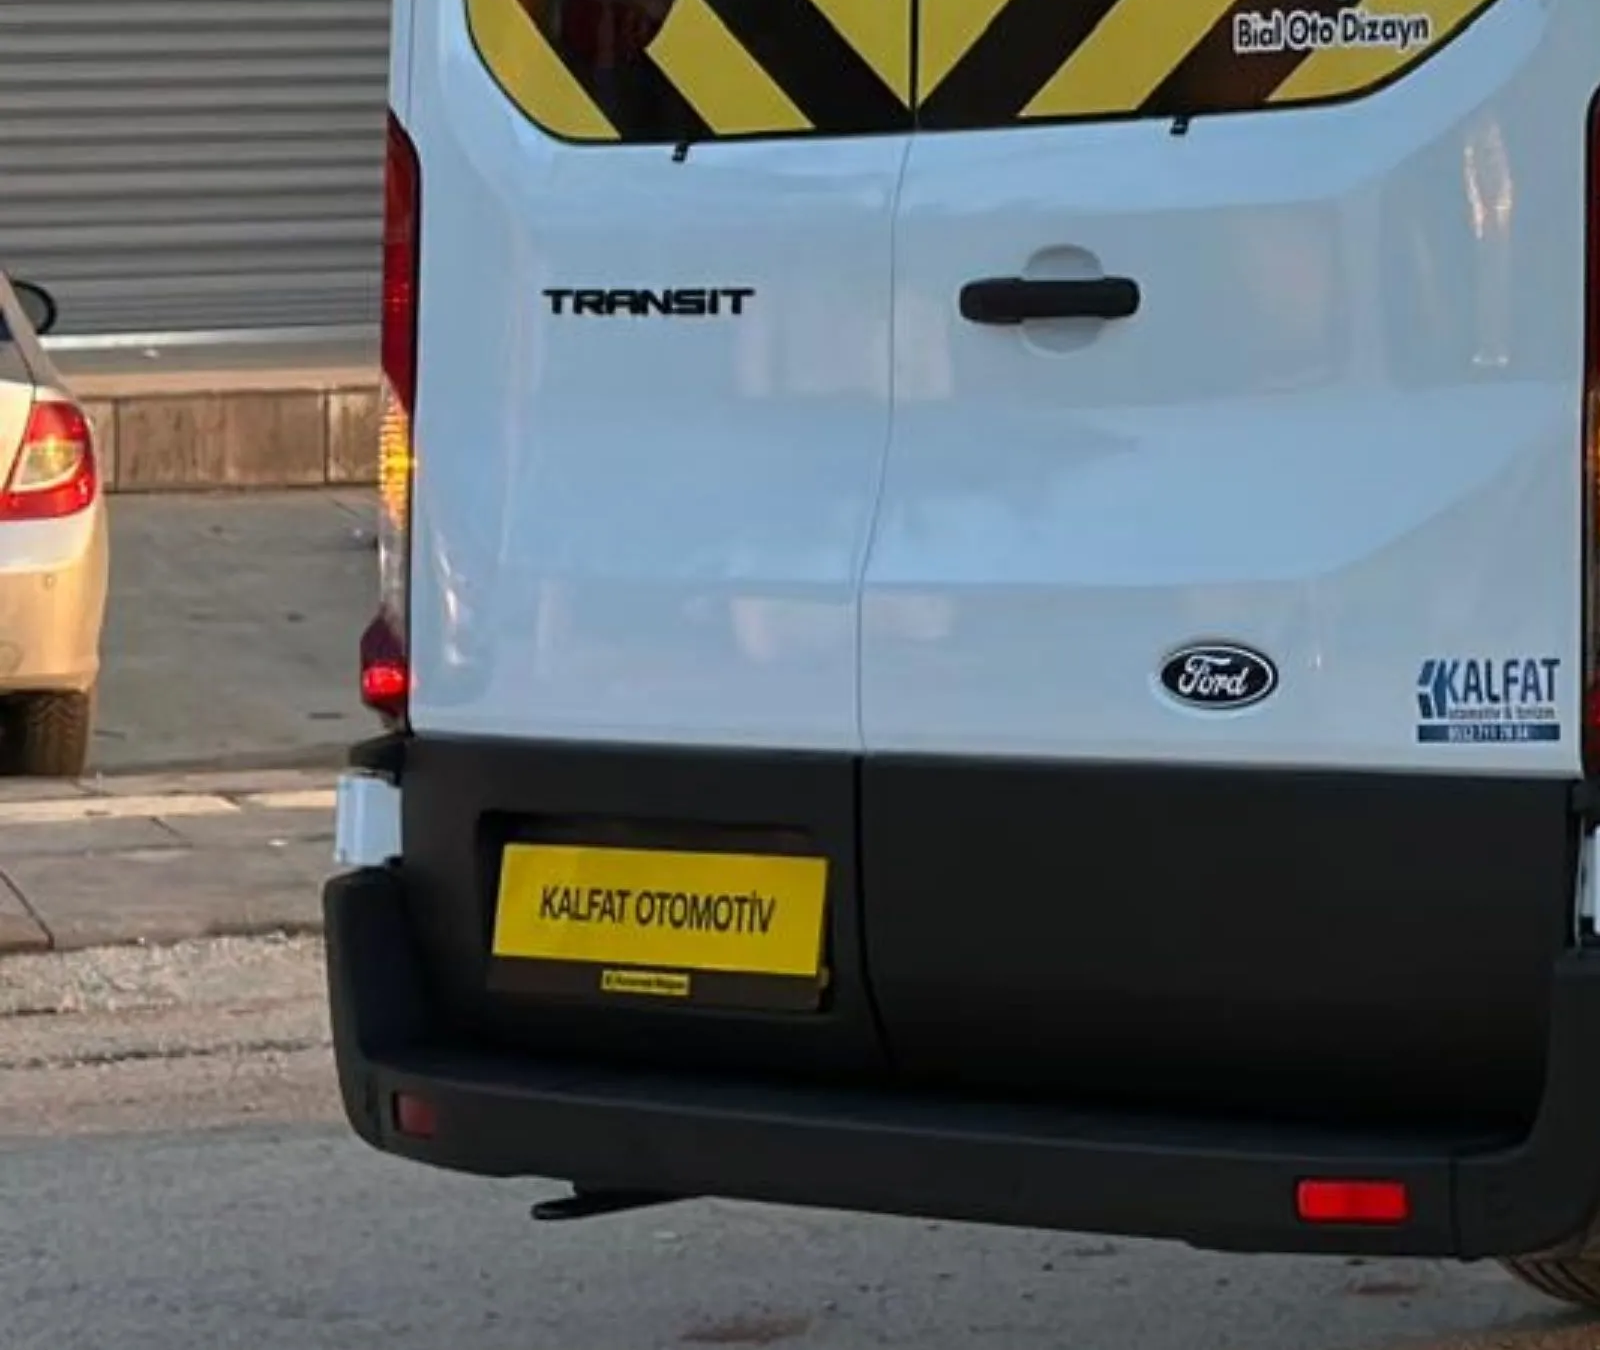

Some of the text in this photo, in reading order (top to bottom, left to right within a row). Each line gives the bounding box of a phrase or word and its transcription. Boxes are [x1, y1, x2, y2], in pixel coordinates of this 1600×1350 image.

[1288, 10, 1336, 49] Oto
[1340, 9, 1431, 52] Dizayn
[542, 288, 755, 317] TRANSIT
[1178, 654, 1249, 696] Ford
[1432, 658, 1561, 705] KALFAT
[540, 884, 776, 934] KALFAT OTOMOTİV
